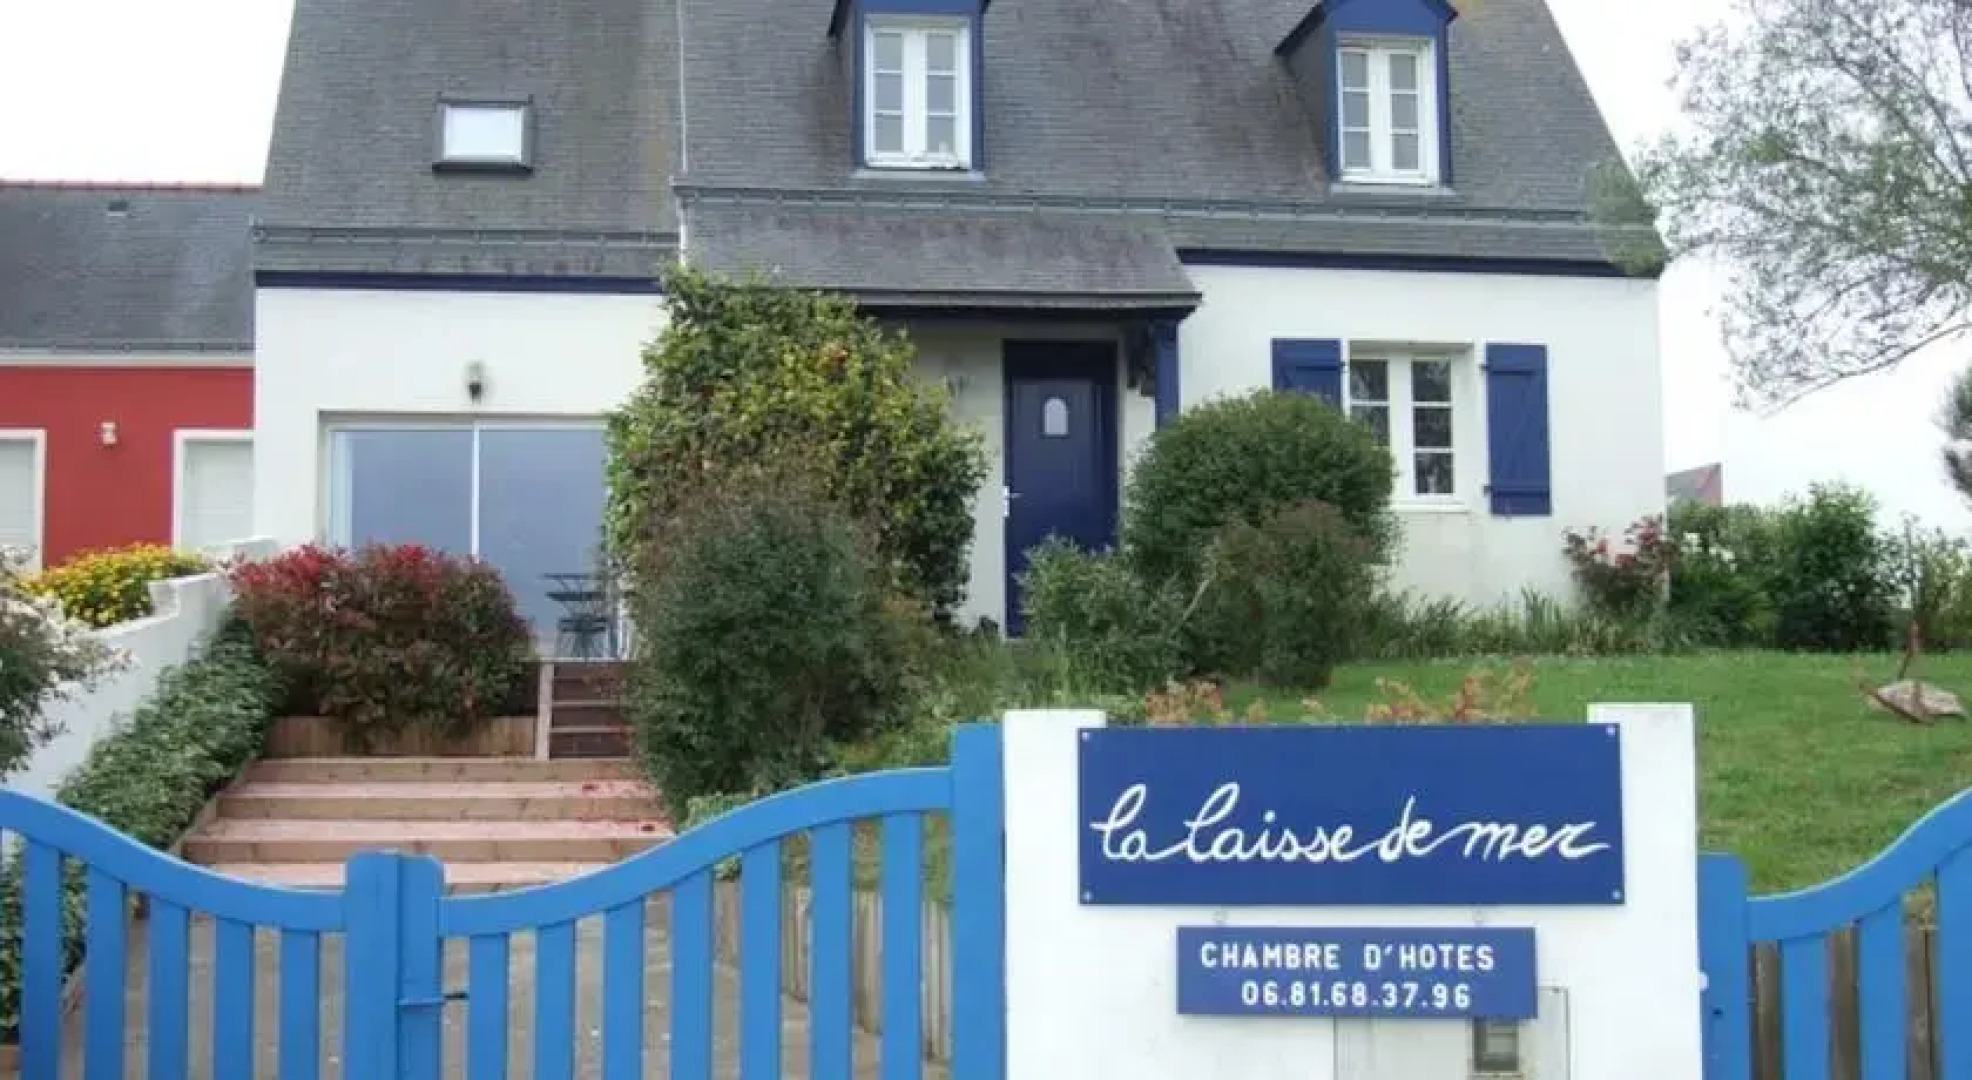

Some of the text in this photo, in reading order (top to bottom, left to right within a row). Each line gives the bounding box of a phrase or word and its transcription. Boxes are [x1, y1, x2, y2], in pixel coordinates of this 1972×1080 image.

[1090, 782, 1170, 862] la
[1180, 781, 1378, 863] laisse
[1200, 941, 1496, 970] CHAMBRE D'HOTES
[1241, 980, 1473, 1009] 06.81.68.37.96
